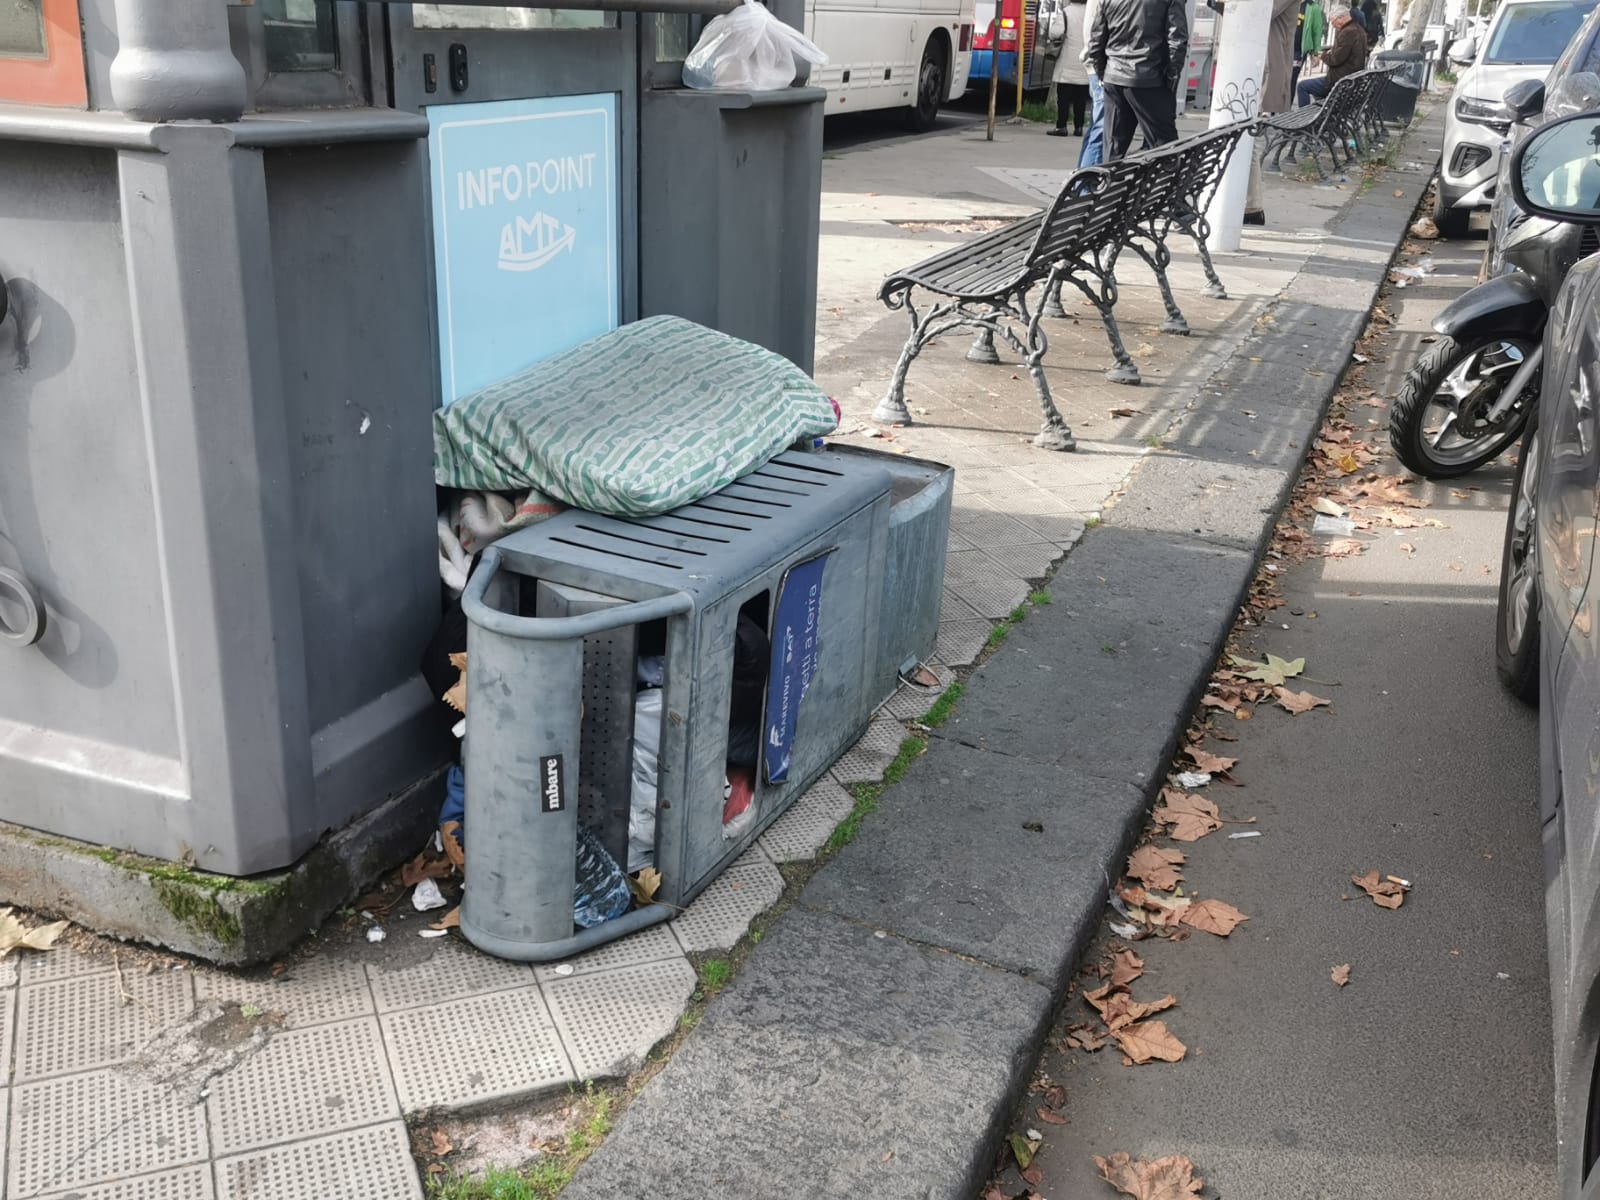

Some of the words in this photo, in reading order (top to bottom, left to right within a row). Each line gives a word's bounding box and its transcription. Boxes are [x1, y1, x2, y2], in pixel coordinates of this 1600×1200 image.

[457, 164, 523, 210] INFO
[526, 152, 596, 198] POINT
[499, 211, 561, 258] AMT
[804, 584, 817, 633] terra
[545, 758, 560, 810] mbare
